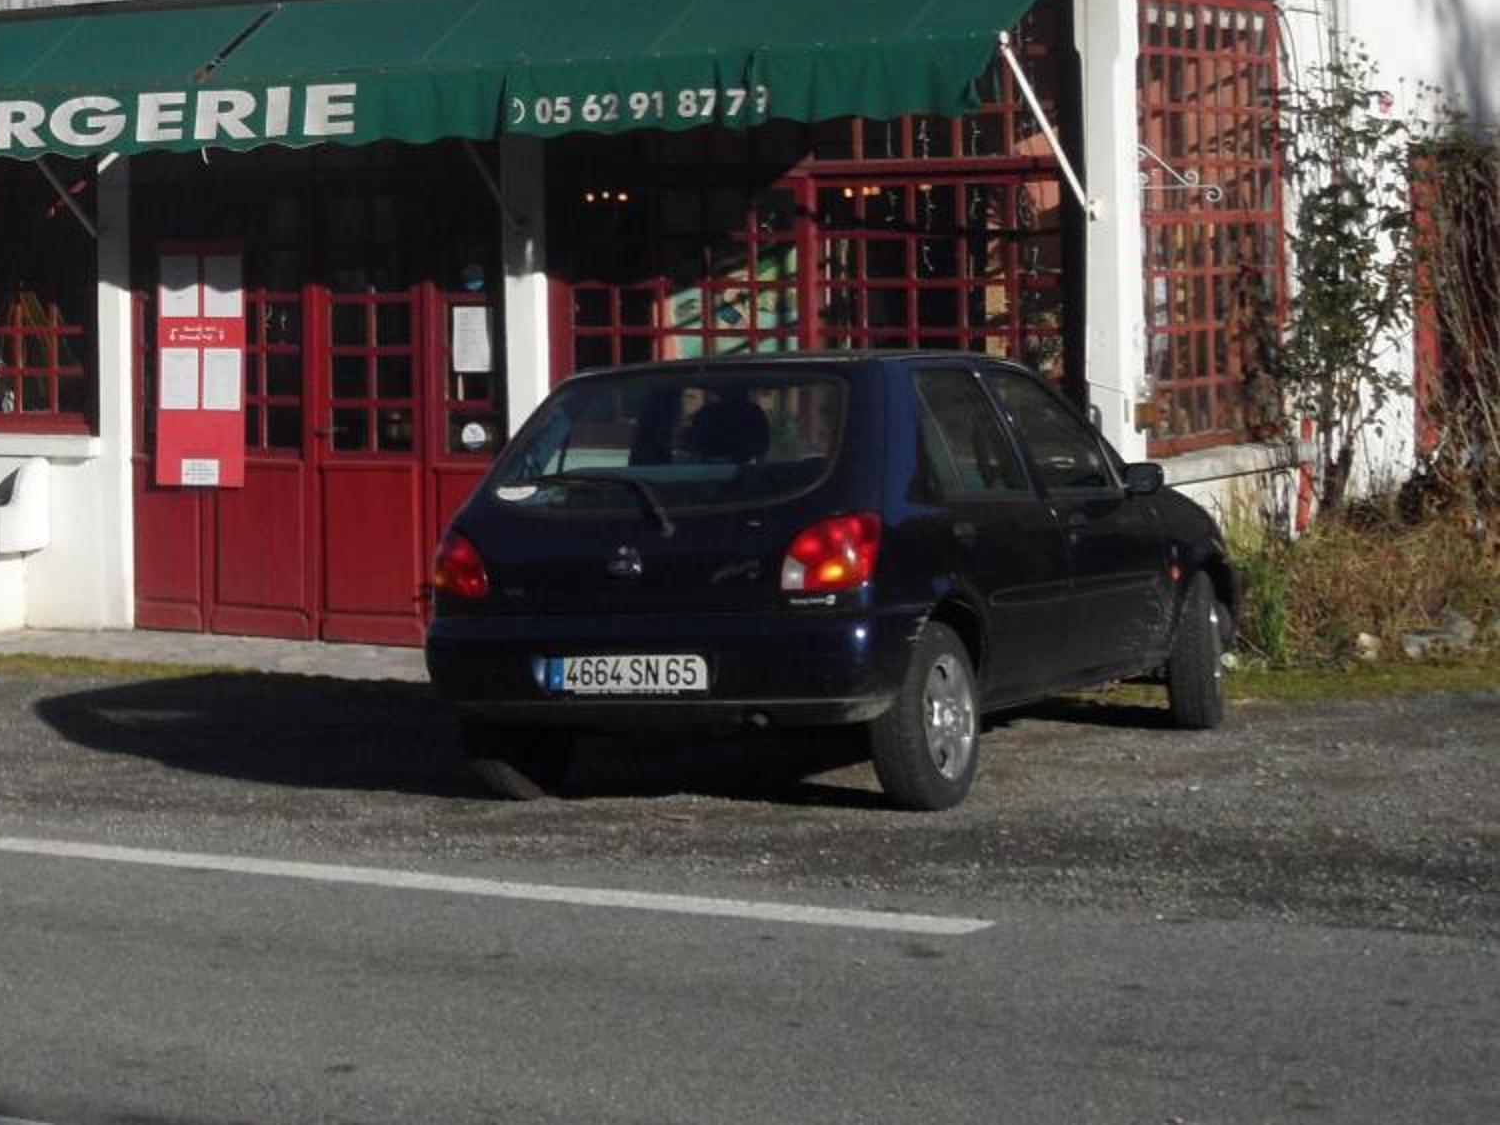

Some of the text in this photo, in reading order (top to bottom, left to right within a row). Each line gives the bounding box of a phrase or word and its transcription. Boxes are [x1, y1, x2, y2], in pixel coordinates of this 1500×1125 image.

[534, 96, 572, 124] 05
[581, 93, 620, 123] 62
[628, 90, 665, 120] 91
[677, 88, 717, 118] 87
[566, 658, 698, 686] 4664 SN 65
